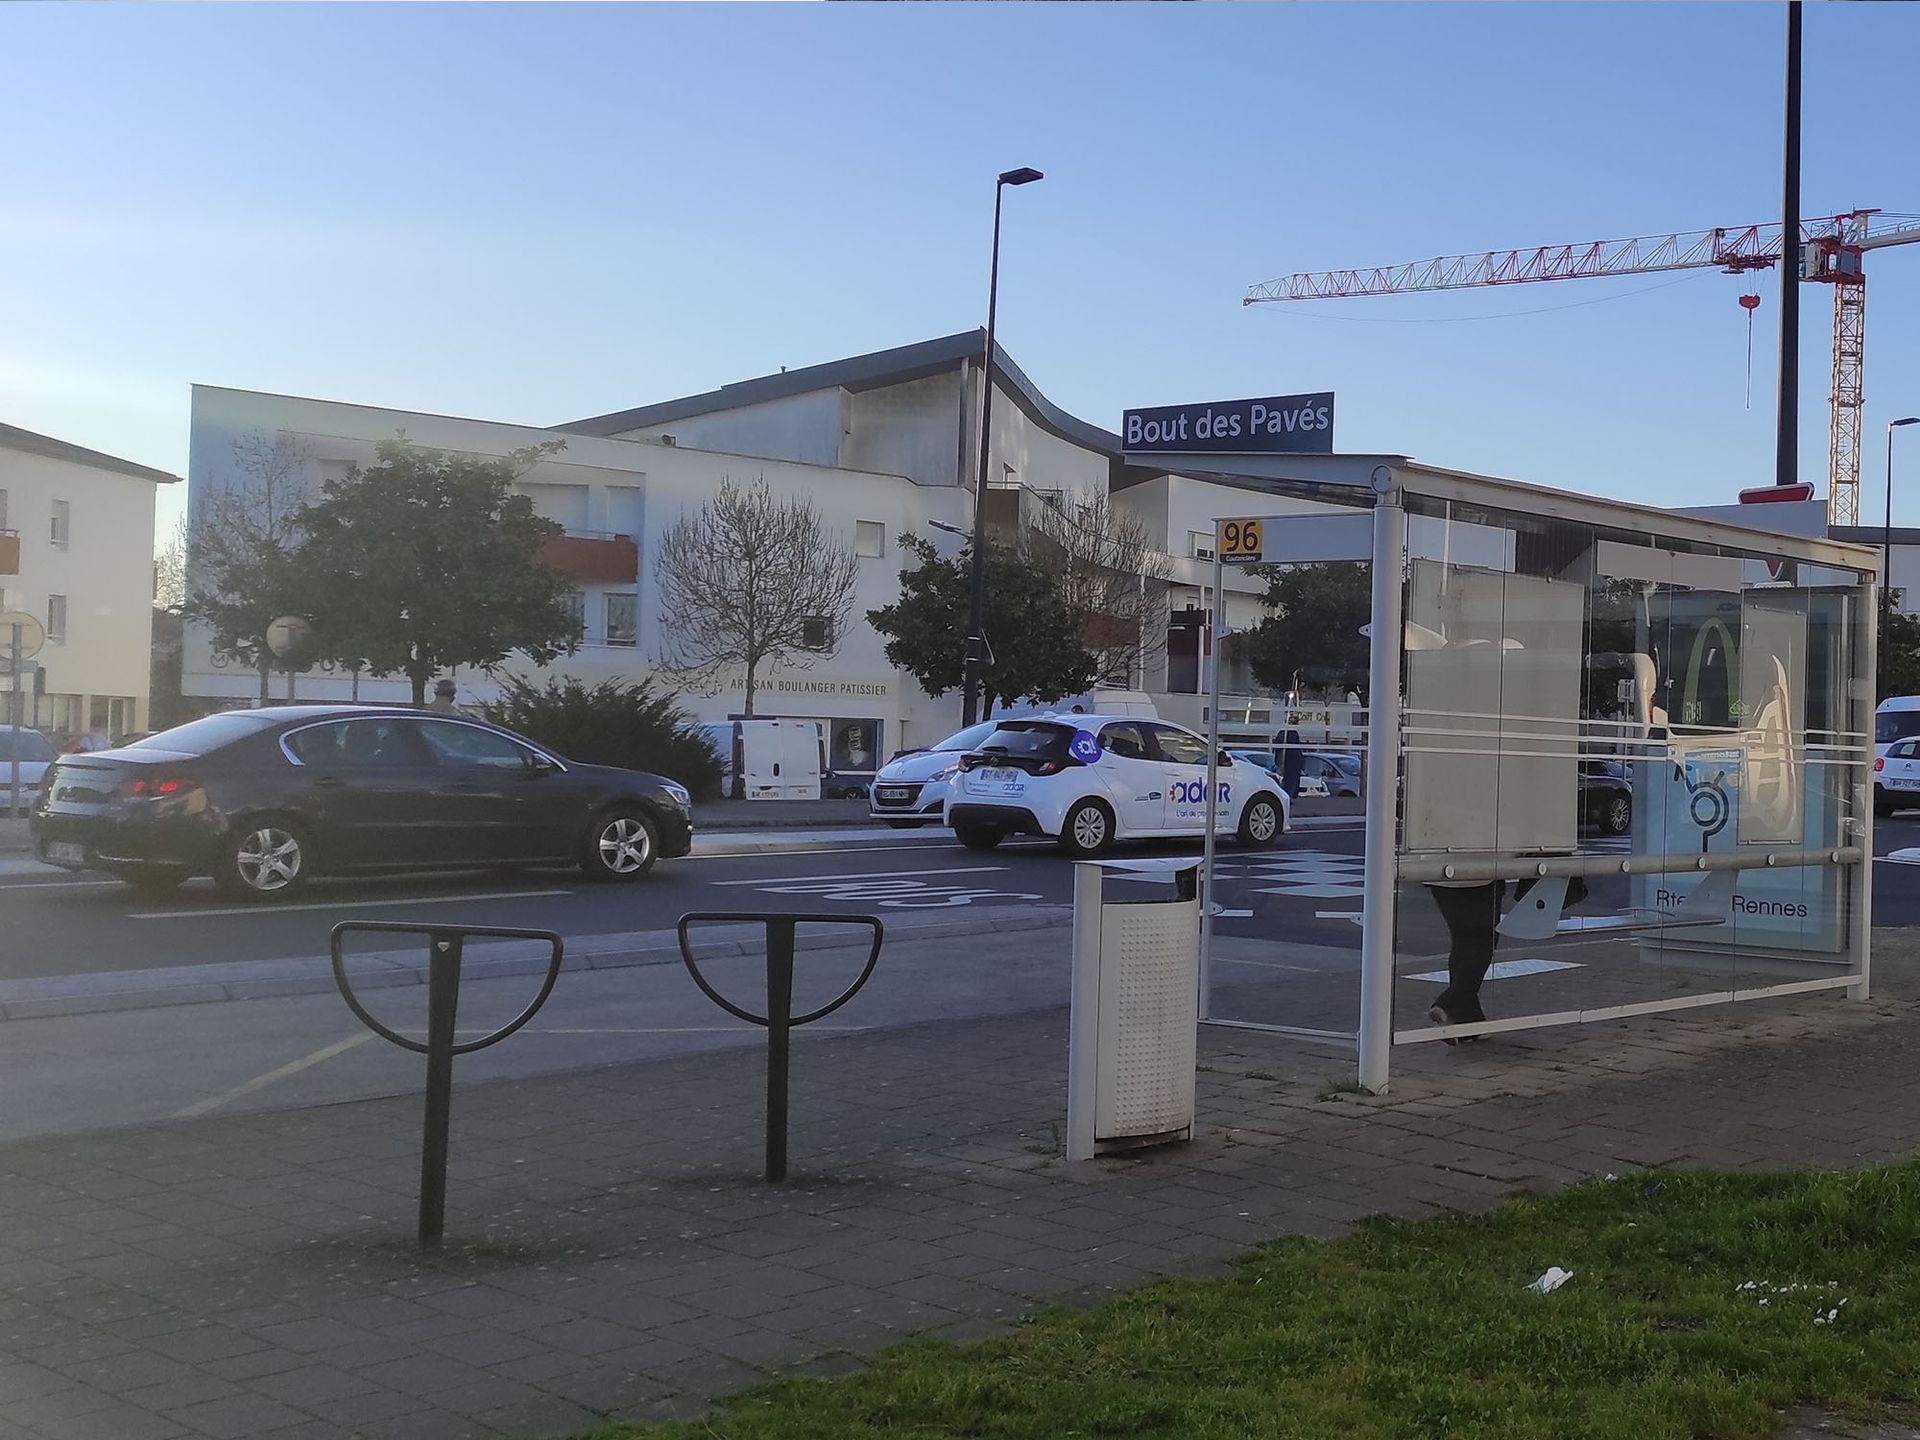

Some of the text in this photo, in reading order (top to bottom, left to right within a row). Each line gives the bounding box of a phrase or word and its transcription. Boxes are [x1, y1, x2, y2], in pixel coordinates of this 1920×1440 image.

[1127, 400, 1329, 444] Bout des Pavés
[1224, 521, 1258, 551] 96
[778, 681, 836, 693] BOULANGER
[840, 683, 887, 696] PATISSIER
[752, 880, 1044, 907] BUS
[1731, 895, 1808, 918] Rennes
